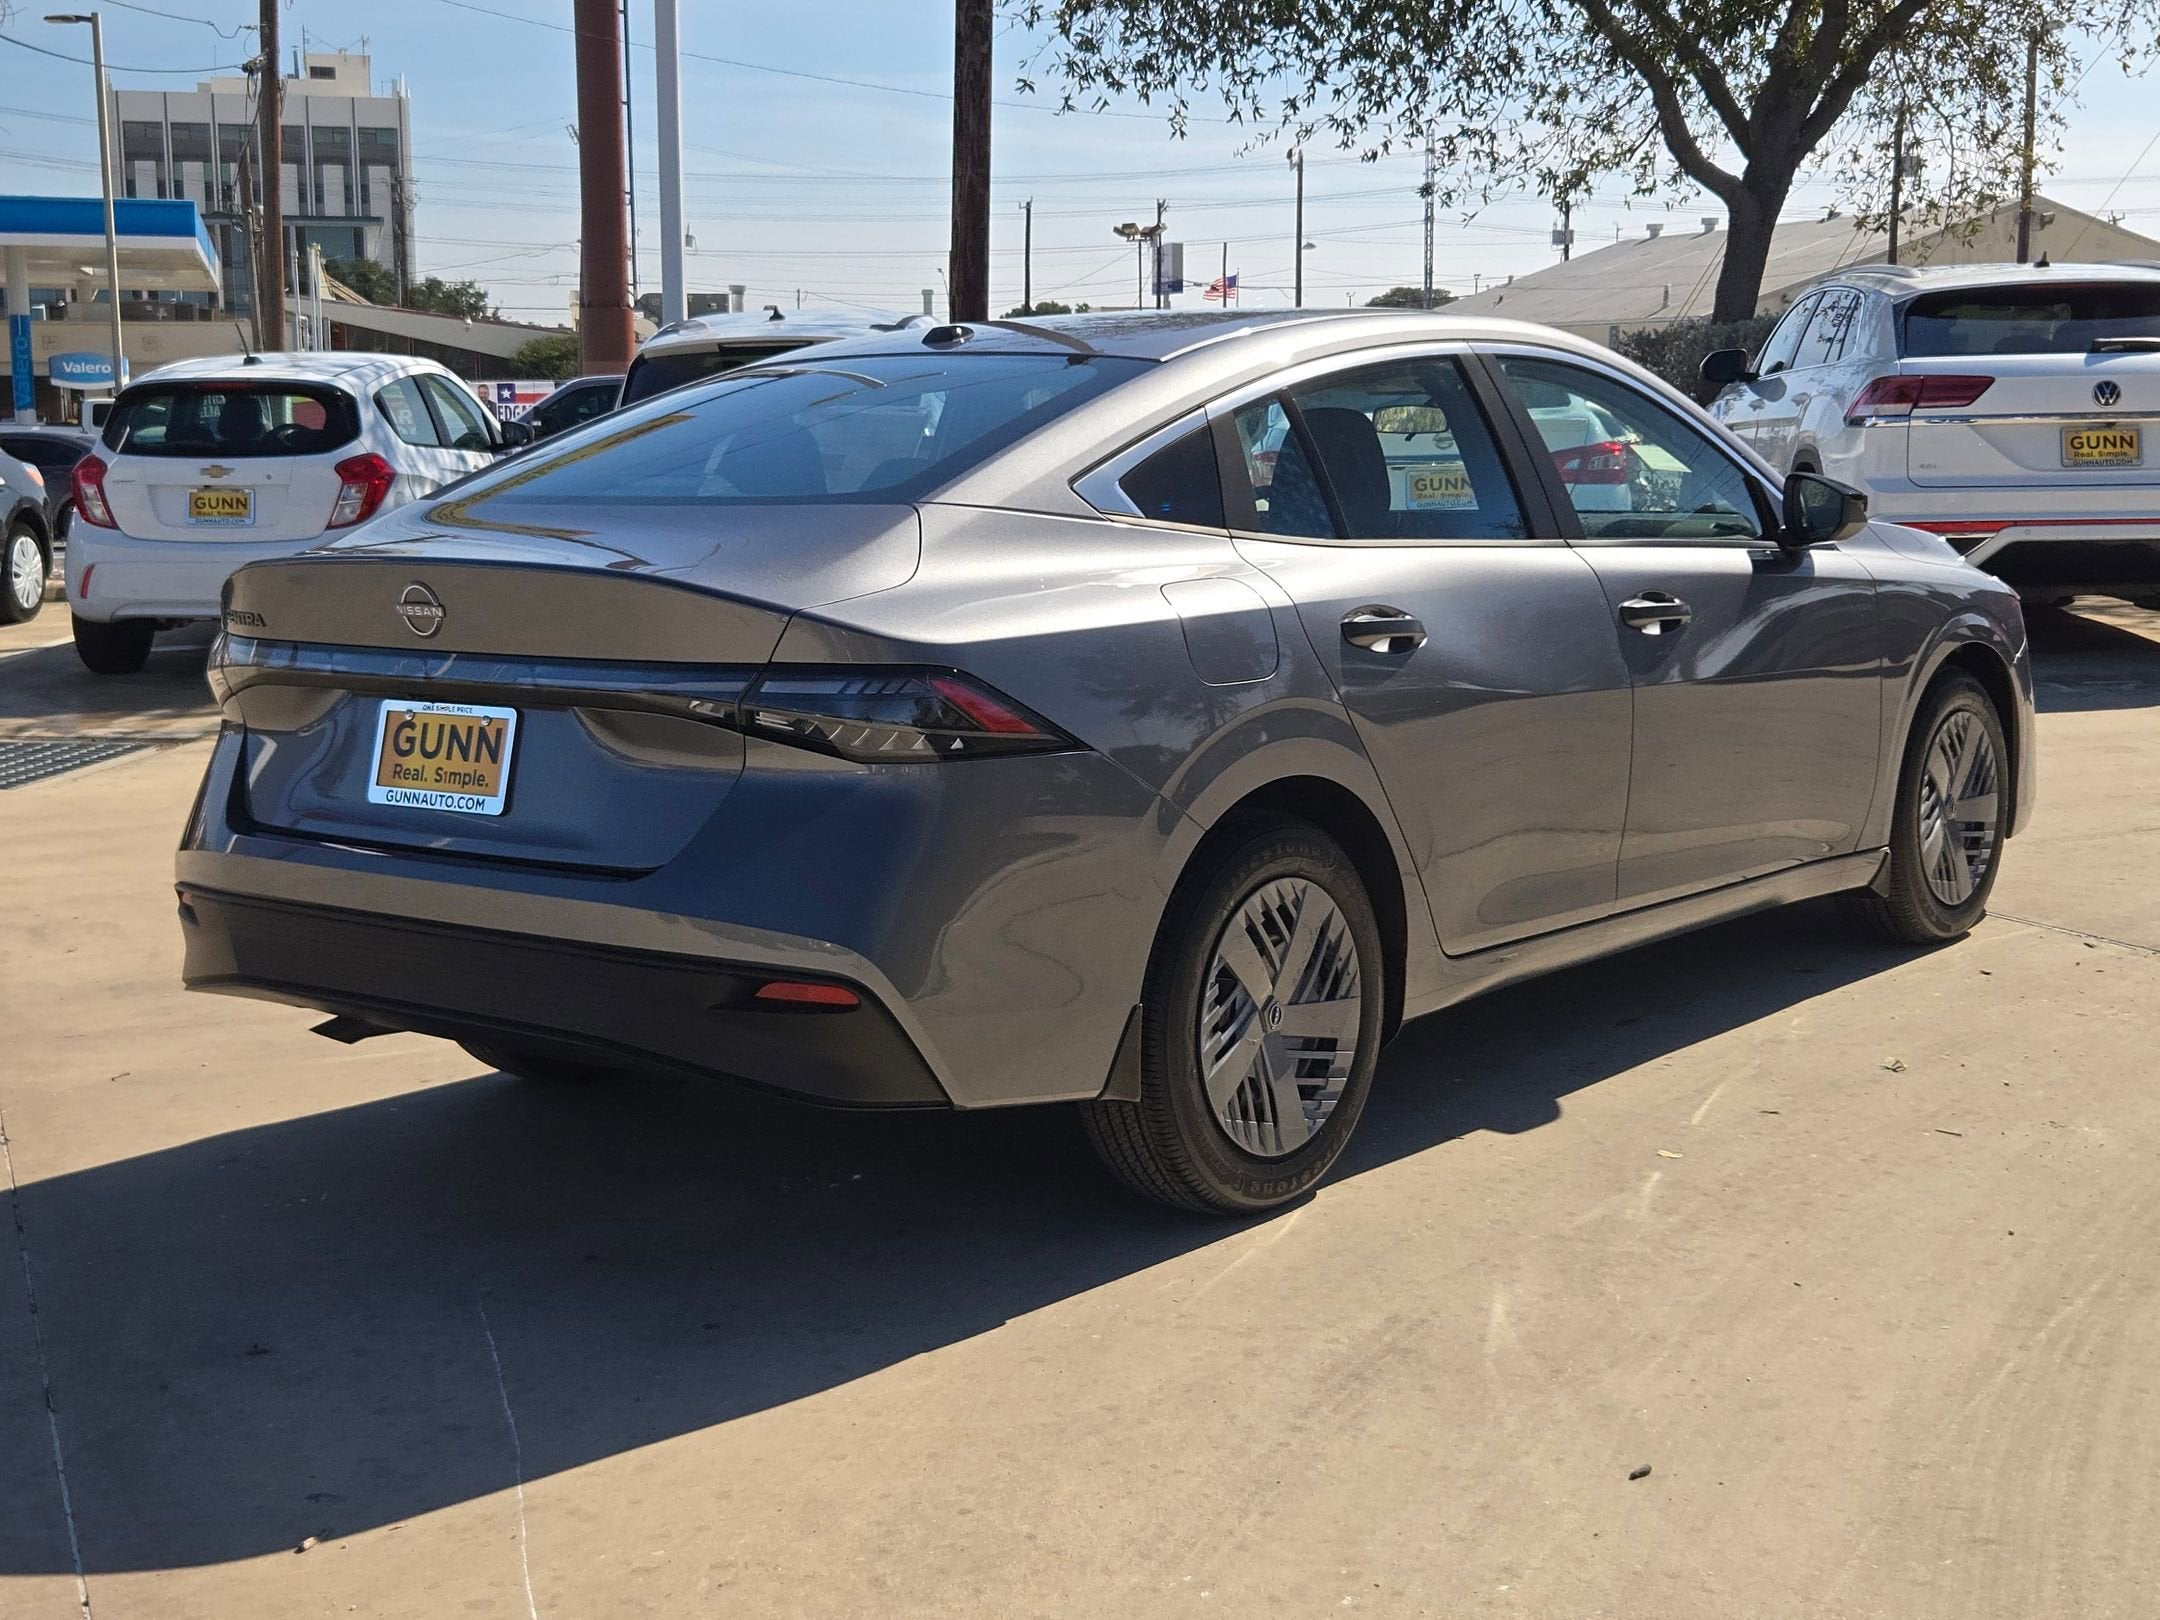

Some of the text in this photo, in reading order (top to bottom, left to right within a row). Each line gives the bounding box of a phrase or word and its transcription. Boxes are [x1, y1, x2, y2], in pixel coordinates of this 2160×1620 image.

[62, 361, 112, 374] Valero
[2069, 435, 2134, 450] GUNN
[194, 497, 248, 510] GUNN
[396, 605, 442, 617] NISSAN
[456, 706, 473, 714] PRICE
[393, 720, 503, 765] GUNN
[392, 763, 428, 782] Real.
[385, 789, 486, 811] GUNNAUTO.COM
